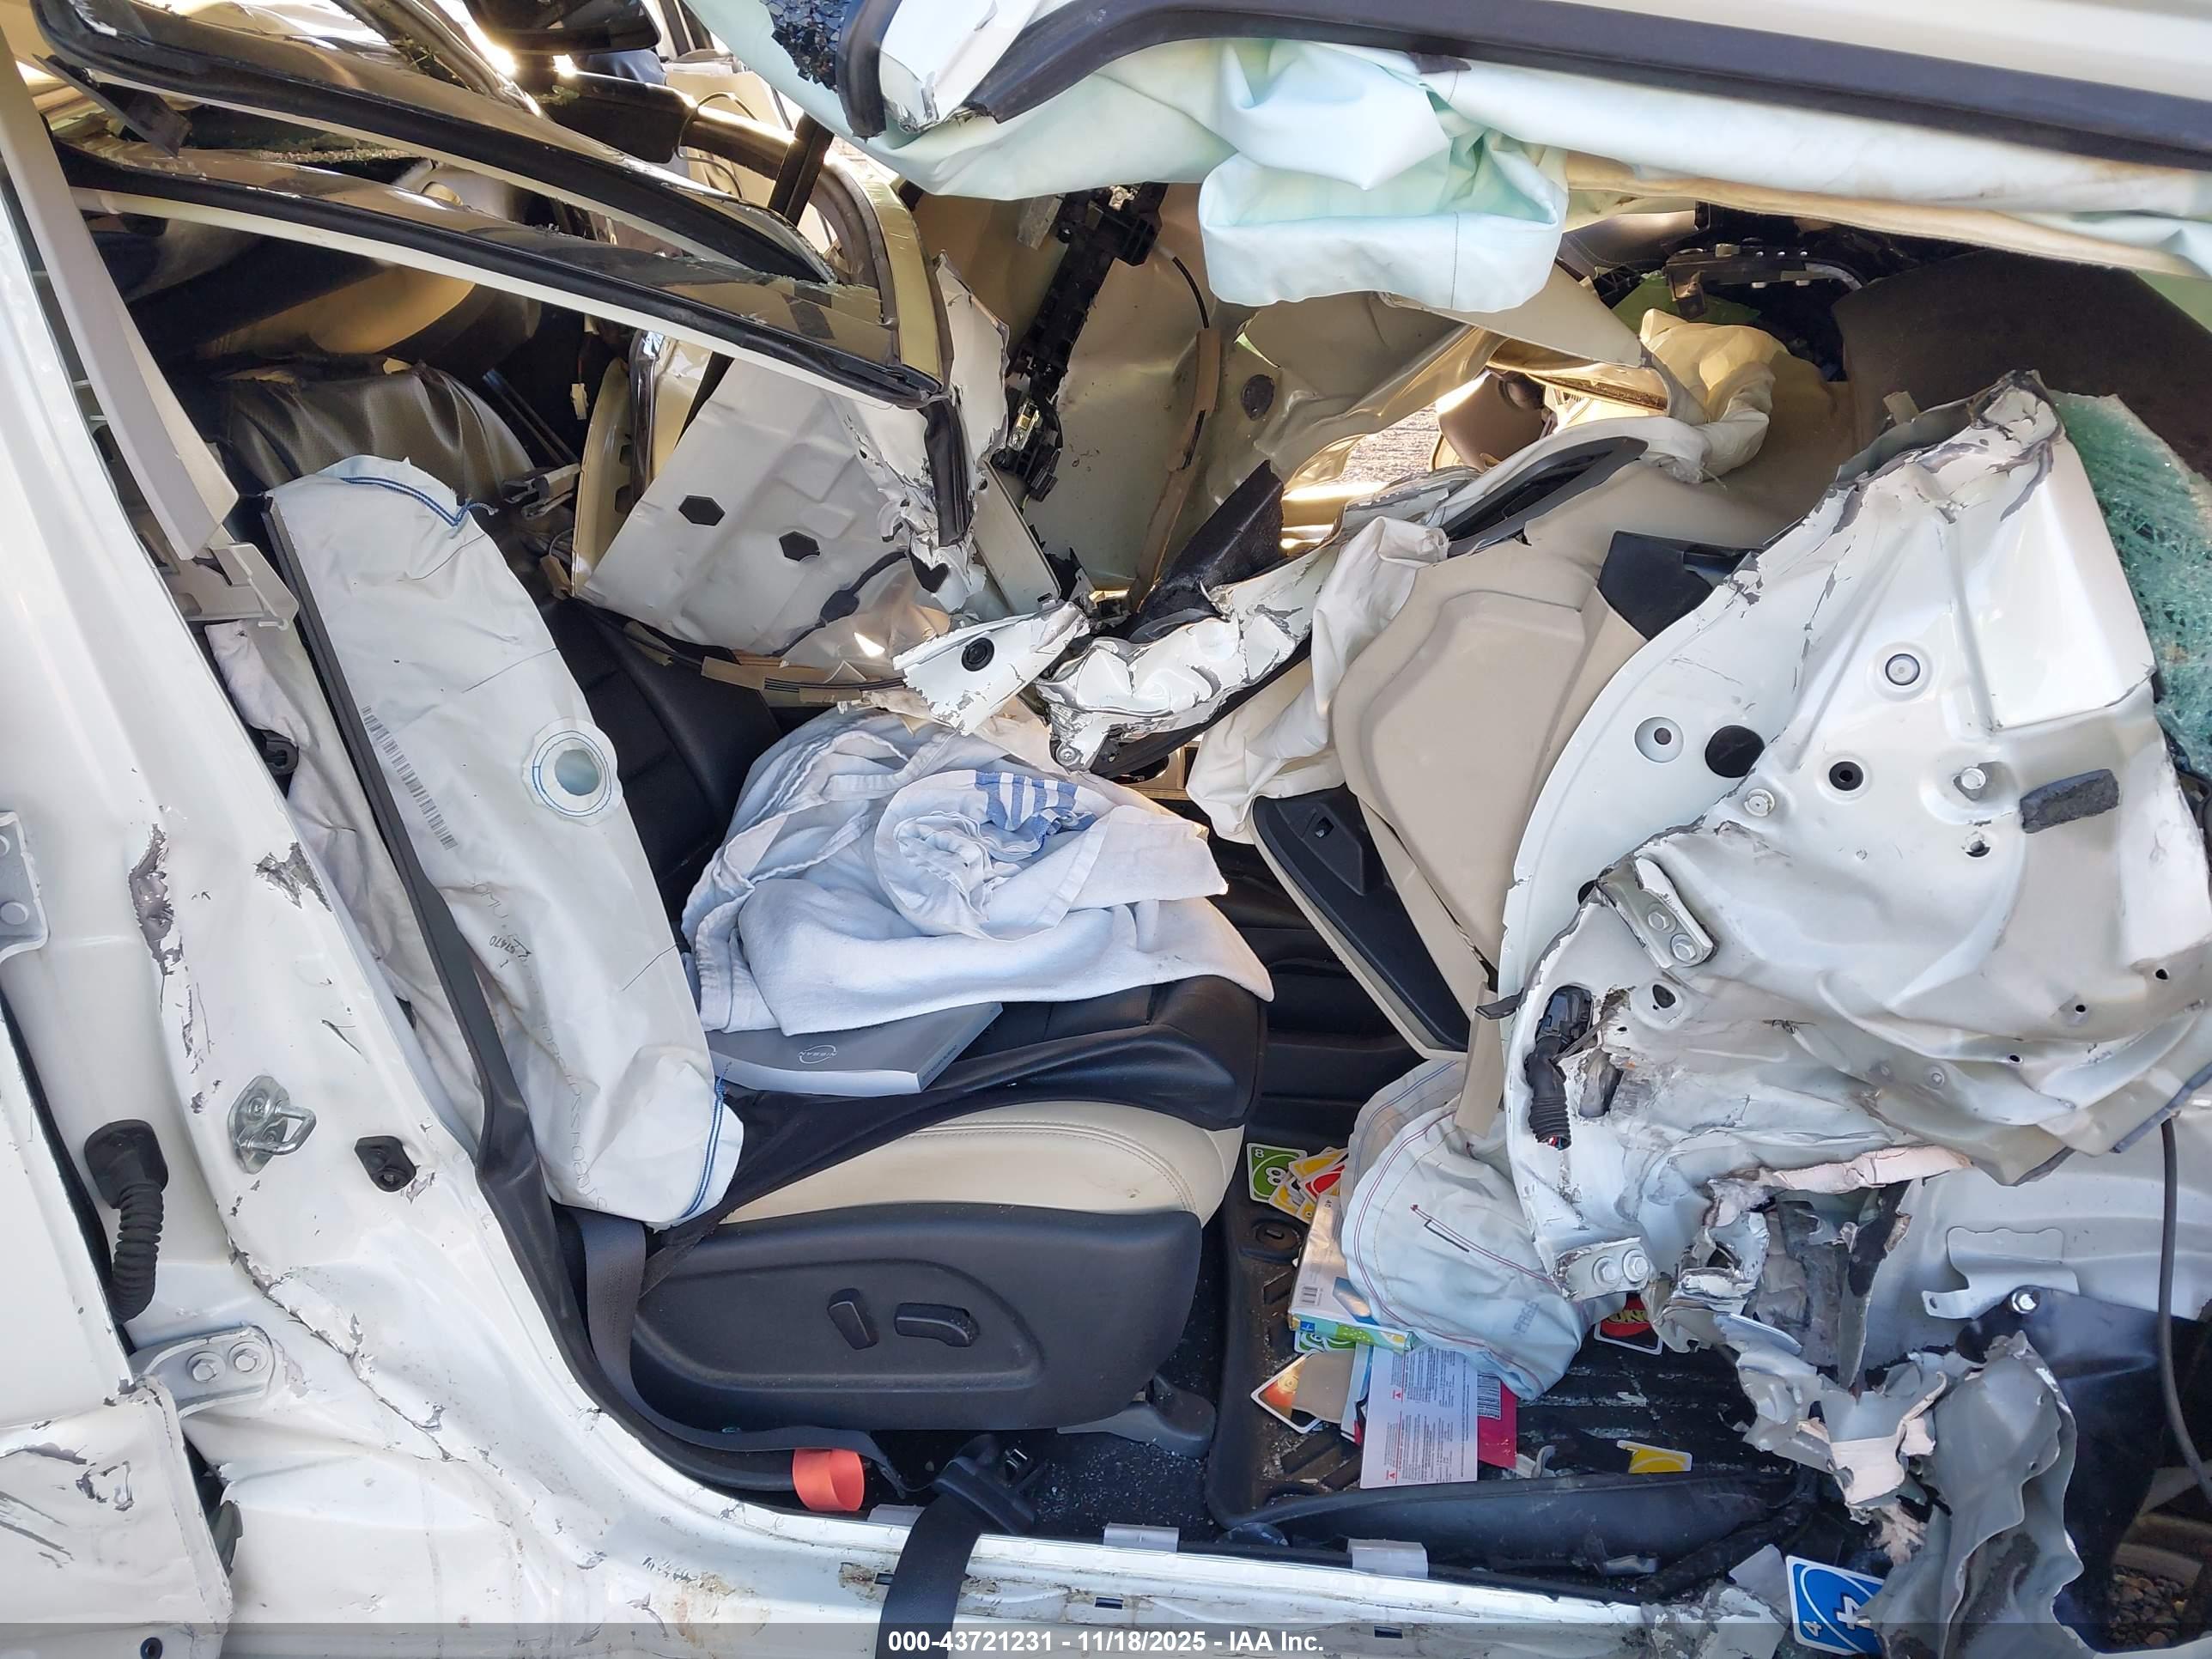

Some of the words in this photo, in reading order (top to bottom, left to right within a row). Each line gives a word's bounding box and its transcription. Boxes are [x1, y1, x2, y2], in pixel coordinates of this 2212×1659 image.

[1255, 1148, 1264, 1158] 8
[1266, 1167, 1286, 1186] 8
[1803, 1620, 1822, 1637] 4
